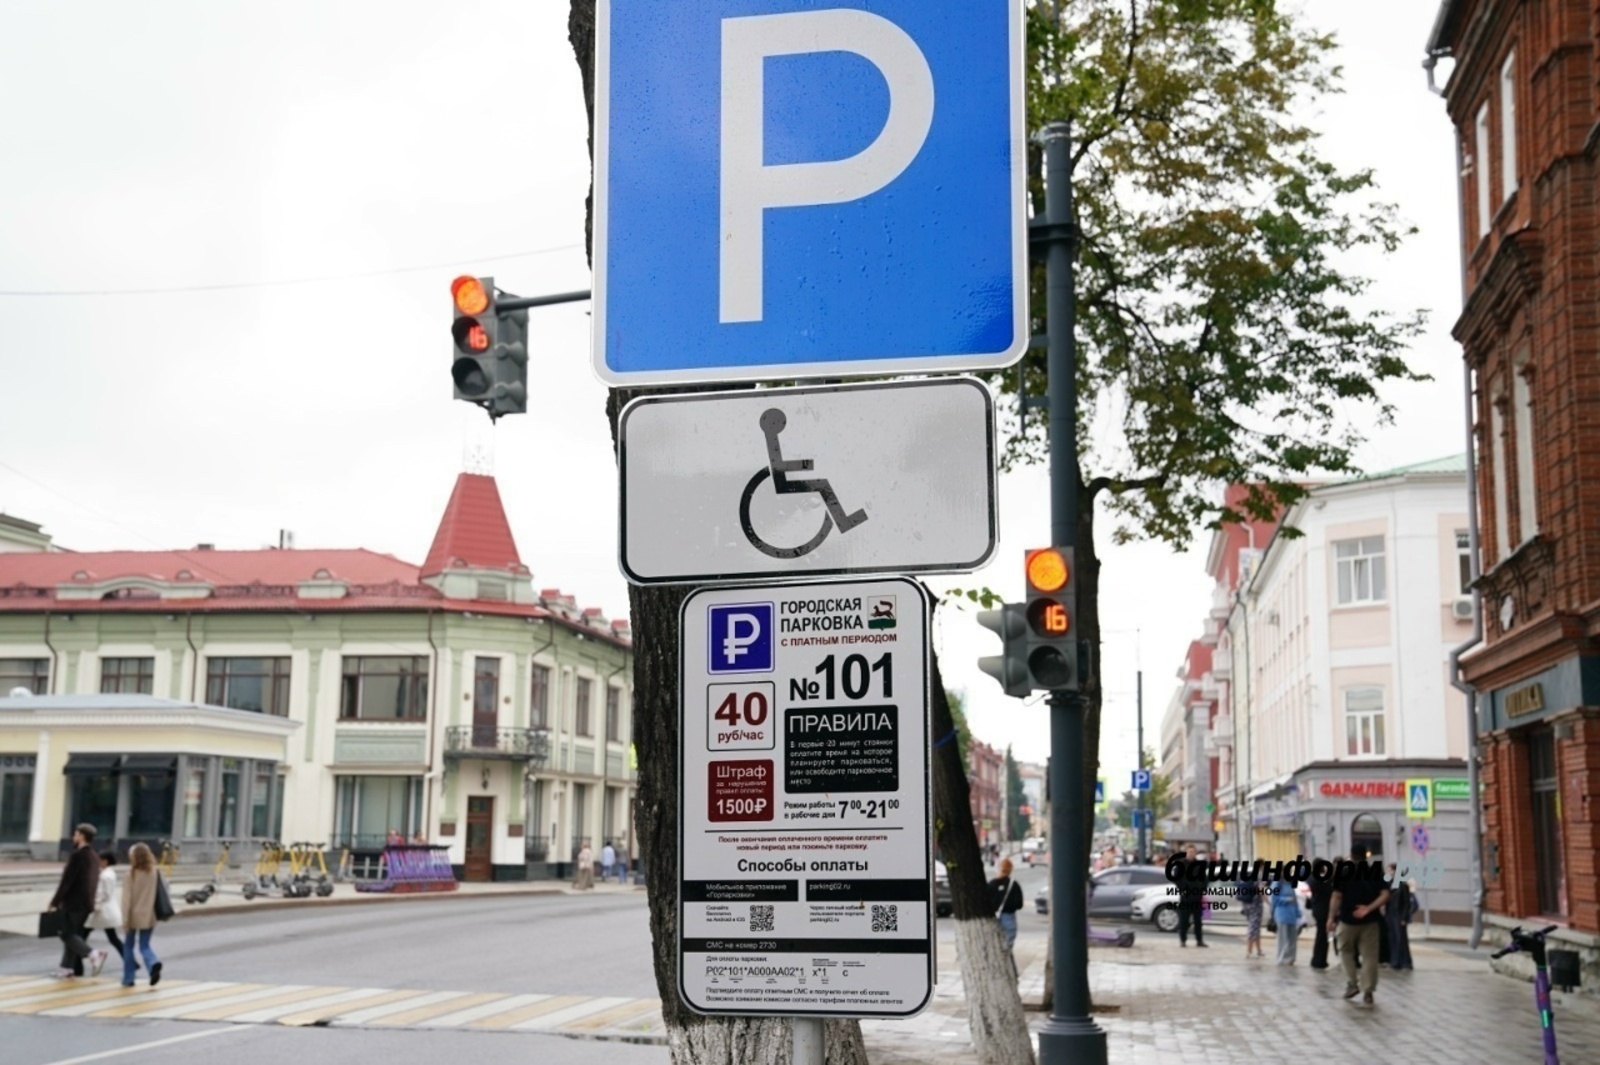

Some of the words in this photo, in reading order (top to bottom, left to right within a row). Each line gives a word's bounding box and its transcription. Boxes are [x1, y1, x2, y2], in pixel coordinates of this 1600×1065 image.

[719, 8, 935, 324] P
[780, 598, 862, 614] ГОРОДСКАЯ
[780, 615, 864, 633] ПАРКОВКА
[1045, 605, 1067, 630] 16
[781, 639, 788, 647] С
[790, 636, 840, 647] ПЛАТНЫМ
[841, 633, 898, 644] ПЕРИОДОМ
[714, 692, 768, 726] 40
[789, 713, 893, 733] ПРАВИЛА
[717, 730, 764, 744] руб/час
[826, 749, 847, 759] время
[863, 748, 893, 757] которое
[790, 759, 835, 767] планируете
[716, 764, 766, 780] Штраф
[784, 801, 808, 810] Режим
[809, 800, 836, 810] работы
[791, 811, 820, 820] рабочие
[760, 843, 786, 851] период
[737, 858, 806, 872] Способы
[810, 859, 869, 872] оплаты
[809, 882, 851, 892] parking02.ru
[706, 941, 723, 949] СМС
